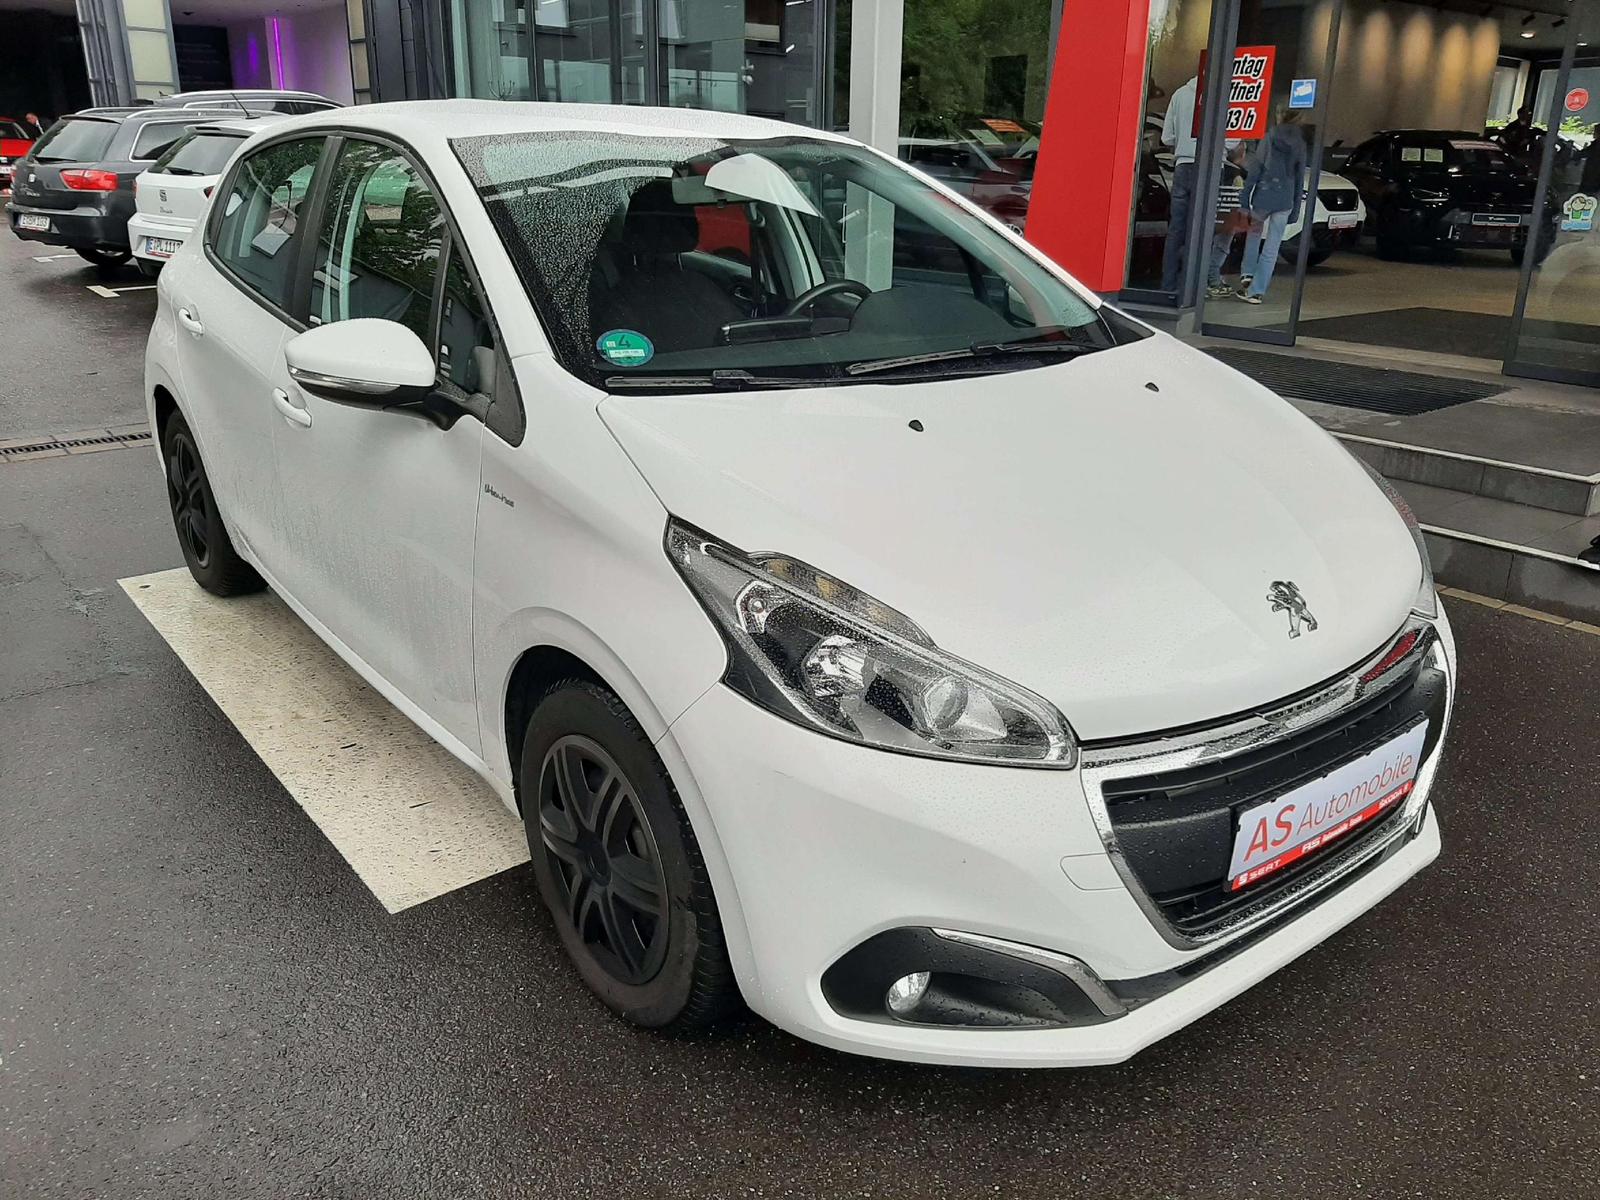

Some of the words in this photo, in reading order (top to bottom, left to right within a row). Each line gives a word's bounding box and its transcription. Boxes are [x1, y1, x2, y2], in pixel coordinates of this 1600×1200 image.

[1232, 54, 1268, 79] ntag
[1229, 79, 1264, 103] ffnet
[1241, 107, 1257, 131] h
[618, 334, 632, 348] 4
[1243, 803, 1296, 862] AS
[1297, 751, 1413, 836] Automobile
[1249, 859, 1282, 880] SEAT
